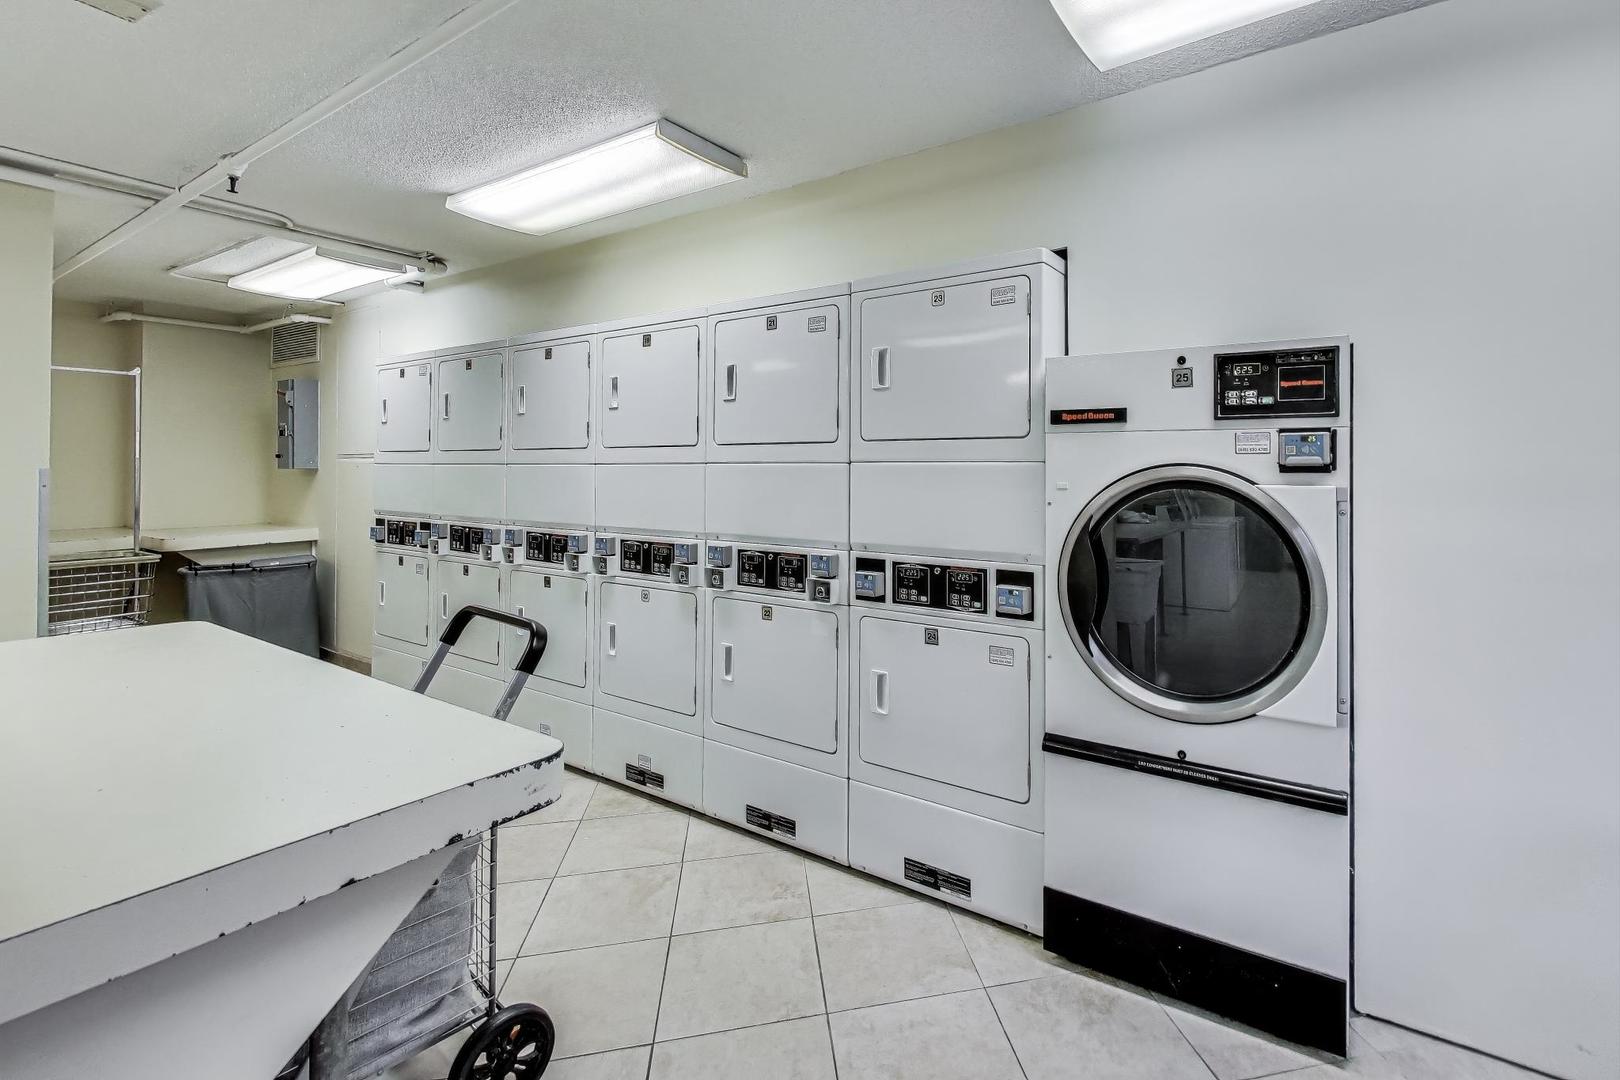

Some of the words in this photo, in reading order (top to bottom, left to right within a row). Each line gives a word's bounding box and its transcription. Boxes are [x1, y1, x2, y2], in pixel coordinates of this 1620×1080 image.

[933, 294, 943, 303] 23
[1175, 373, 1189, 383] 25
[1061, 412, 1088, 421] Speed
[1088, 411, 1115, 420] Queen
[927, 632, 937, 641] 24
